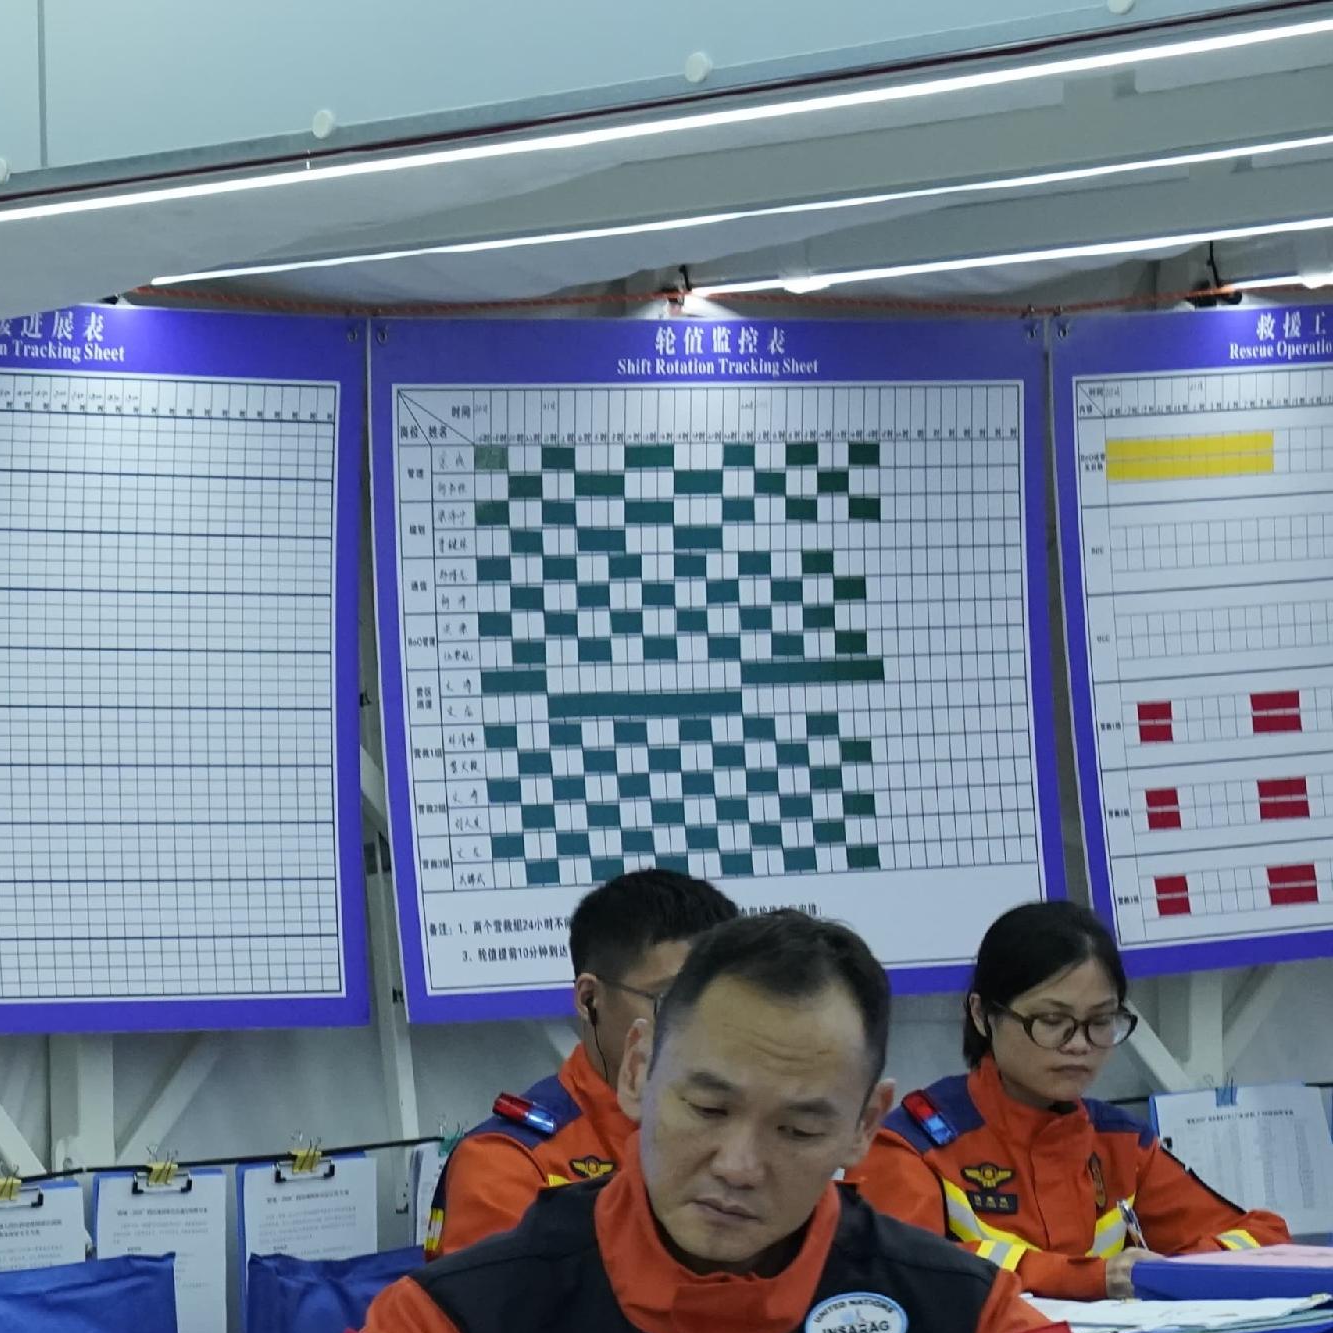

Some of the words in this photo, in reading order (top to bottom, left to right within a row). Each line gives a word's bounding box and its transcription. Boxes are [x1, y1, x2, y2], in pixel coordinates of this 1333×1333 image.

[12, 339, 81, 364] Tracking
[83, 342, 125, 363] Sheet
[655, 326, 786, 356] 轮值监控表
[1229, 342, 1274, 360] Rescue
[617, 358, 651, 376] Shift
[655, 358, 714, 376] Rotation
[718, 357, 779, 378] Tracking
[783, 357, 819, 375] Sheet
[813, 1301, 847, 1323] UNITED
[849, 1300, 893, 1314] NATIONS
